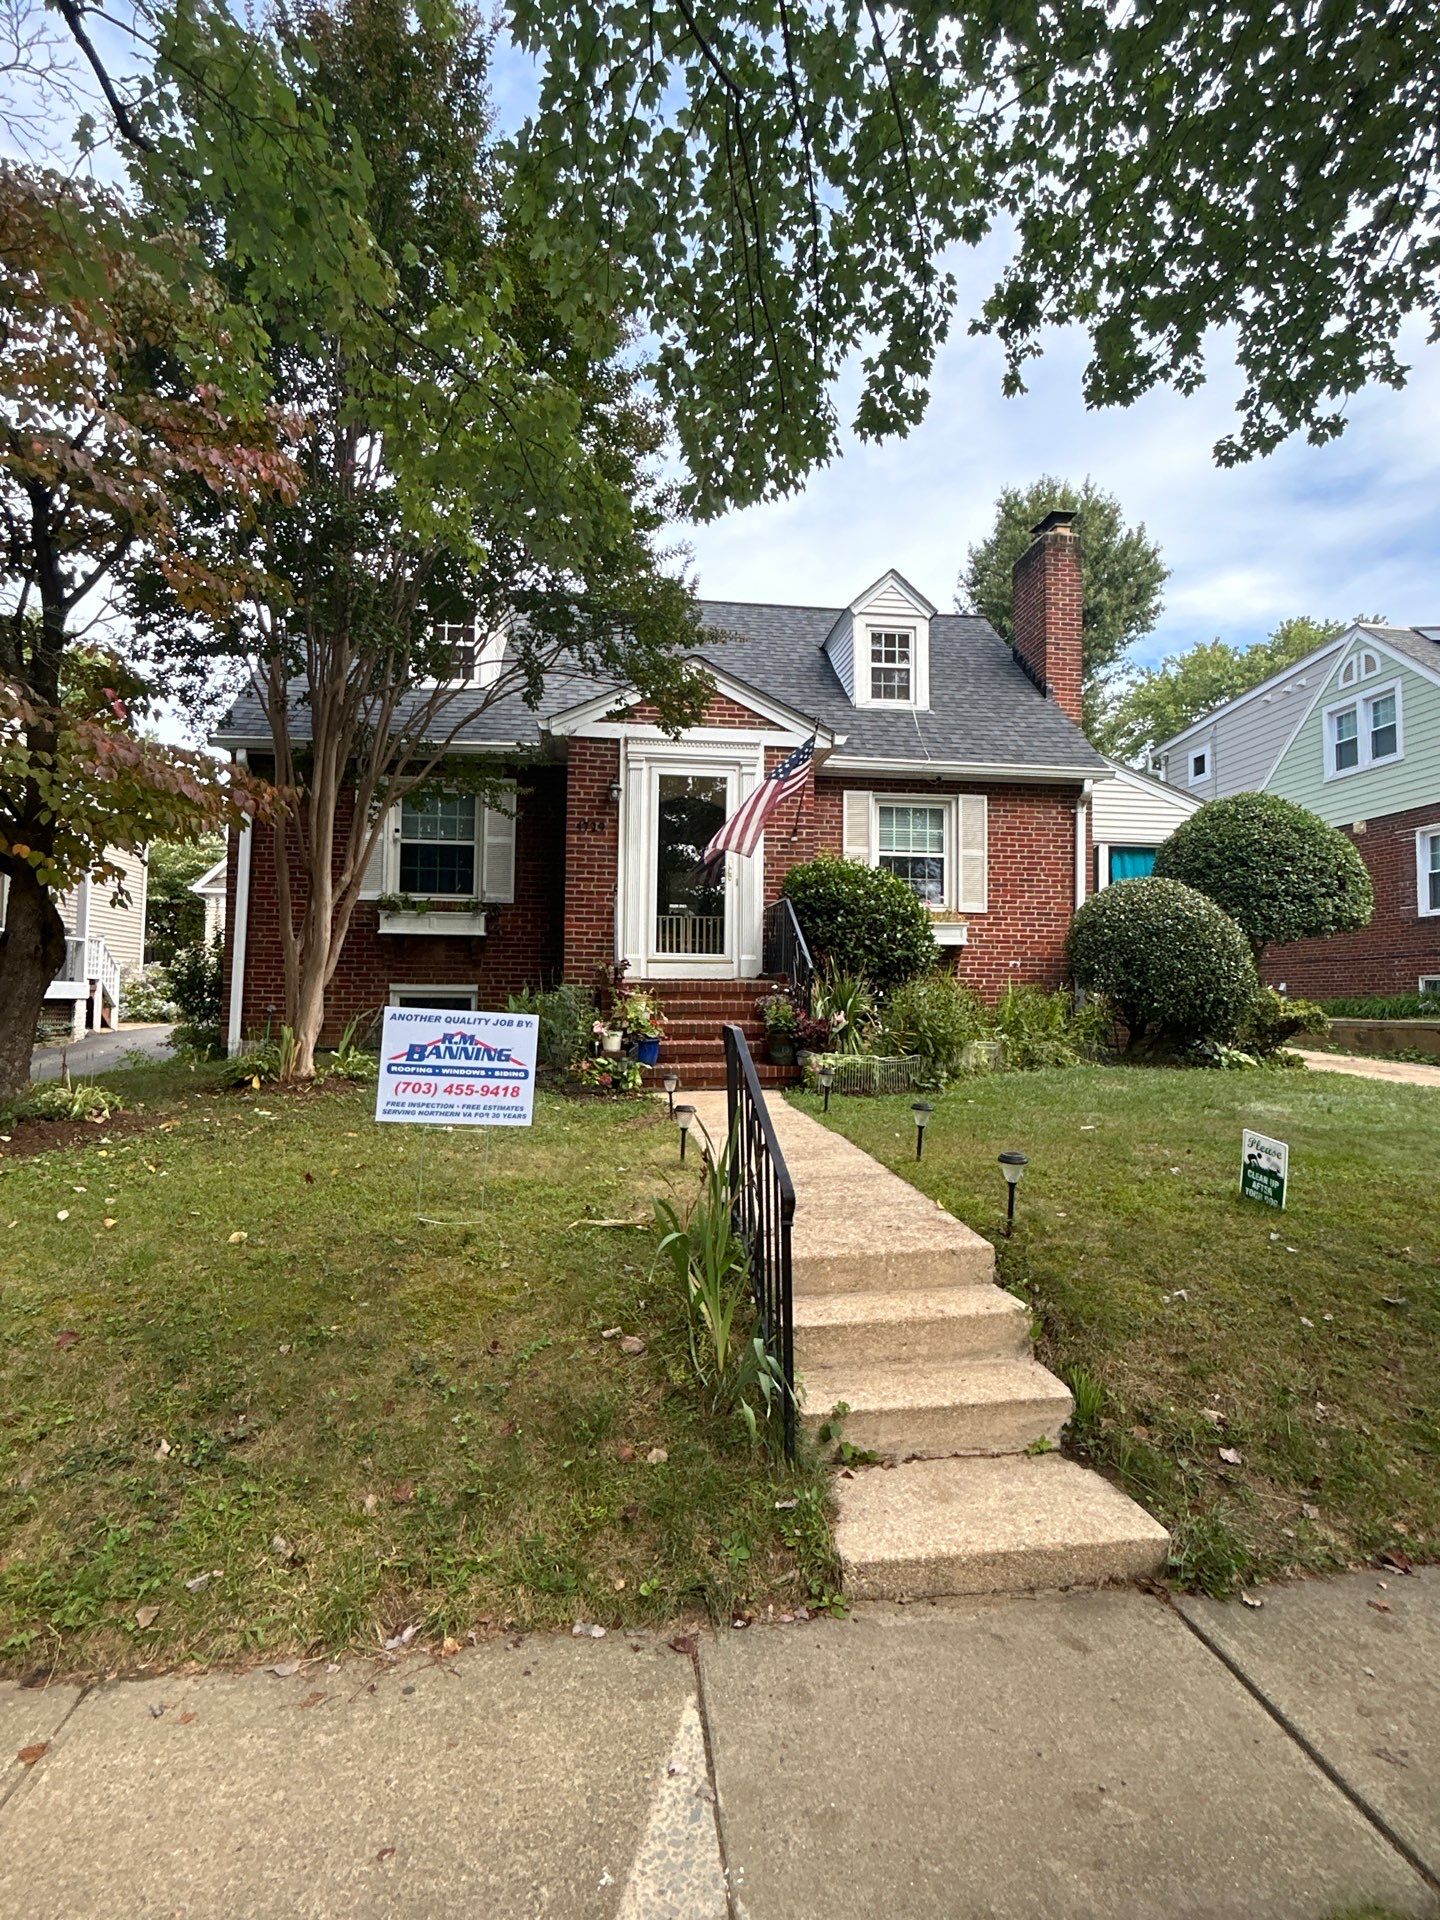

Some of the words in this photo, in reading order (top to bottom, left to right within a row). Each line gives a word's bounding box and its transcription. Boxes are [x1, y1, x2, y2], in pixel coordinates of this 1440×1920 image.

[390, 1013, 441, 1023] ANOTHER
[444, 1016, 491, 1026] QUALITY
[492, 1018, 514, 1027] JOB
[516, 1020, 533, 1028] BY:
[441, 1033, 478, 1046] R.M.
[406, 1043, 512, 1062] BANNING
[391, 1066, 433, 1074] ROOFING
[441, 1068, 486, 1076] WINDOWS
[494, 1070, 525, 1078] SIDING
[394, 1081, 438, 1098] (703)
[443, 1083, 520, 1098] 455-9418
[382, 1108, 416, 1116] SERVING
[418, 1109, 460, 1118] NORTHERN
[473, 1111, 490, 1119] FOR
[502, 1112, 527, 1120] YEARS
[482, 1104, 524, 1112] ESTIMATES
[1247, 1137, 1282, 1159] Please
[1247, 1169, 1268, 1185] CLEAN
[1269, 1178, 1280, 1189] UP
[1252, 1180, 1273, 1196] AFTER
